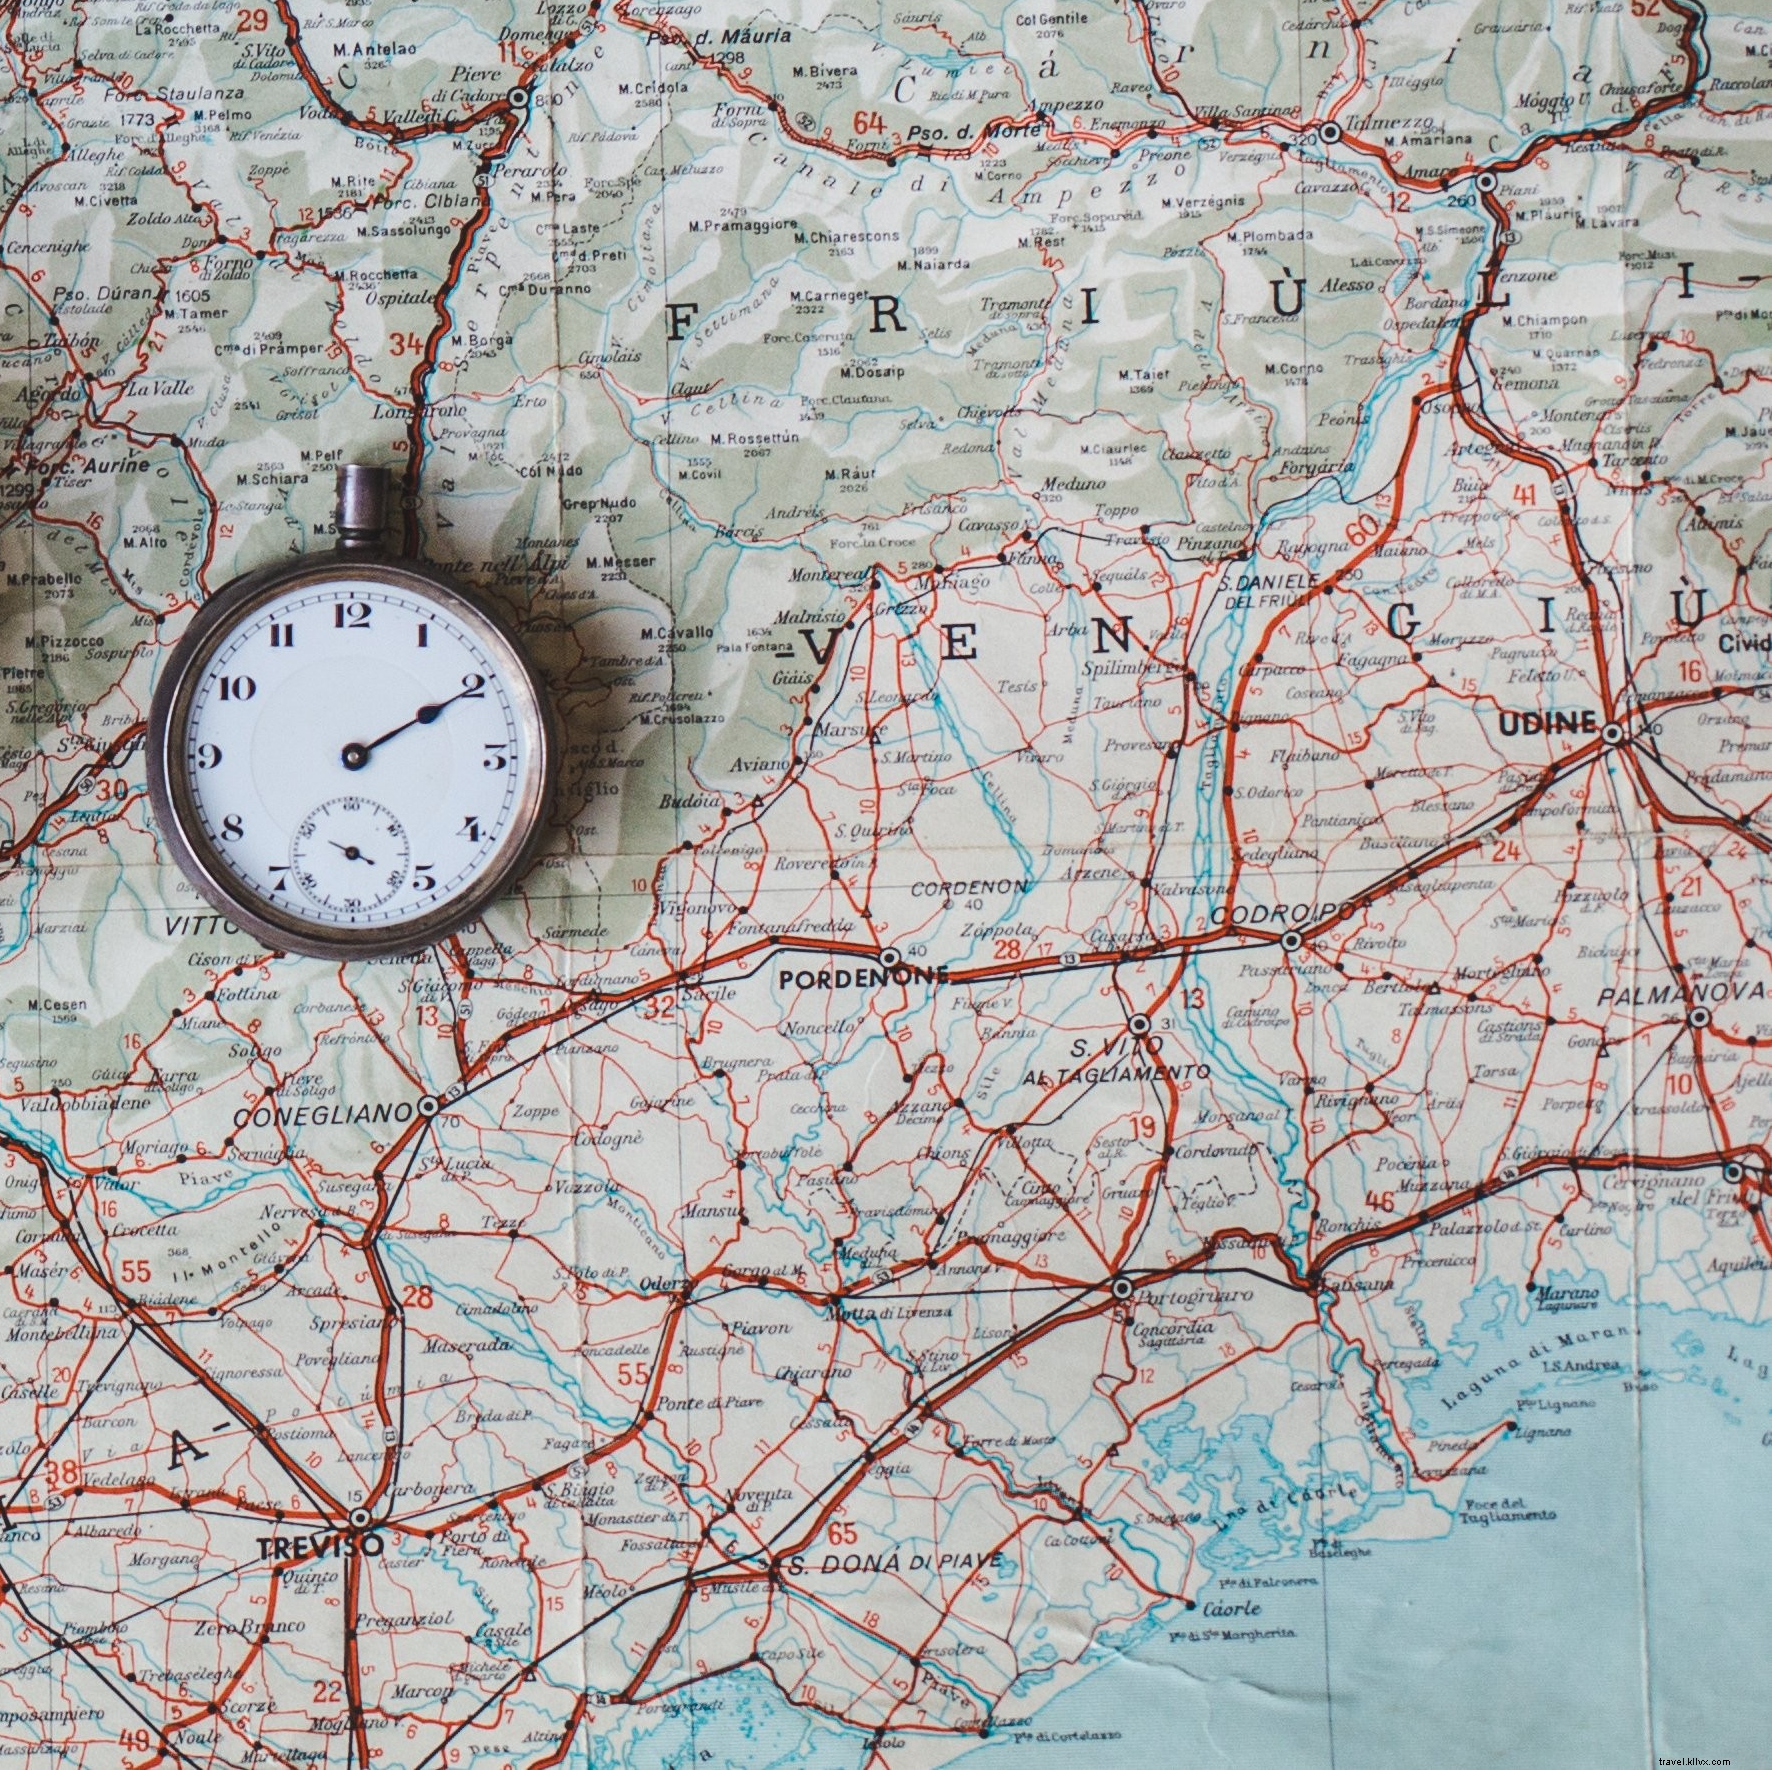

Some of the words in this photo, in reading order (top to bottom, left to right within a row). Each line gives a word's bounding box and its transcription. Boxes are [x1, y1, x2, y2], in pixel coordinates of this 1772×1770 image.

[854, 111, 885, 133] 64
[7, 240, 89, 257] Cencenighe
[1041, 476, 1106, 491] Meduno
[336, 603, 371, 628] 12
[271, 624, 293, 647] 11
[419, 624, 427, 647] 1
[221, 677, 256, 700] 10
[462, 675, 485, 698] 2
[1497, 709, 1598, 737] UDINE
[199, 745, 222, 768] 9
[484, 745, 506, 770] 3
[343, 800, 360, 811] 60
[221, 816, 243, 840] 8
[459, 817, 485, 842] 4
[269, 866, 290, 891] 7
[413, 866, 436, 890] 5
[1209, 900, 1356, 927] CODROIPO
[1598, 982, 1764, 1008] PALMANOVA
[234, 1101, 413, 1129] CONEGLIANO
[1366, 1190, 1394, 1211] 46
[122, 1260, 151, 1282] 55
[401, 1282, 434, 1309] 28
[255, 1531, 385, 1561] TREVISO
[1204, 1600, 1261, 1617] Cáorle
